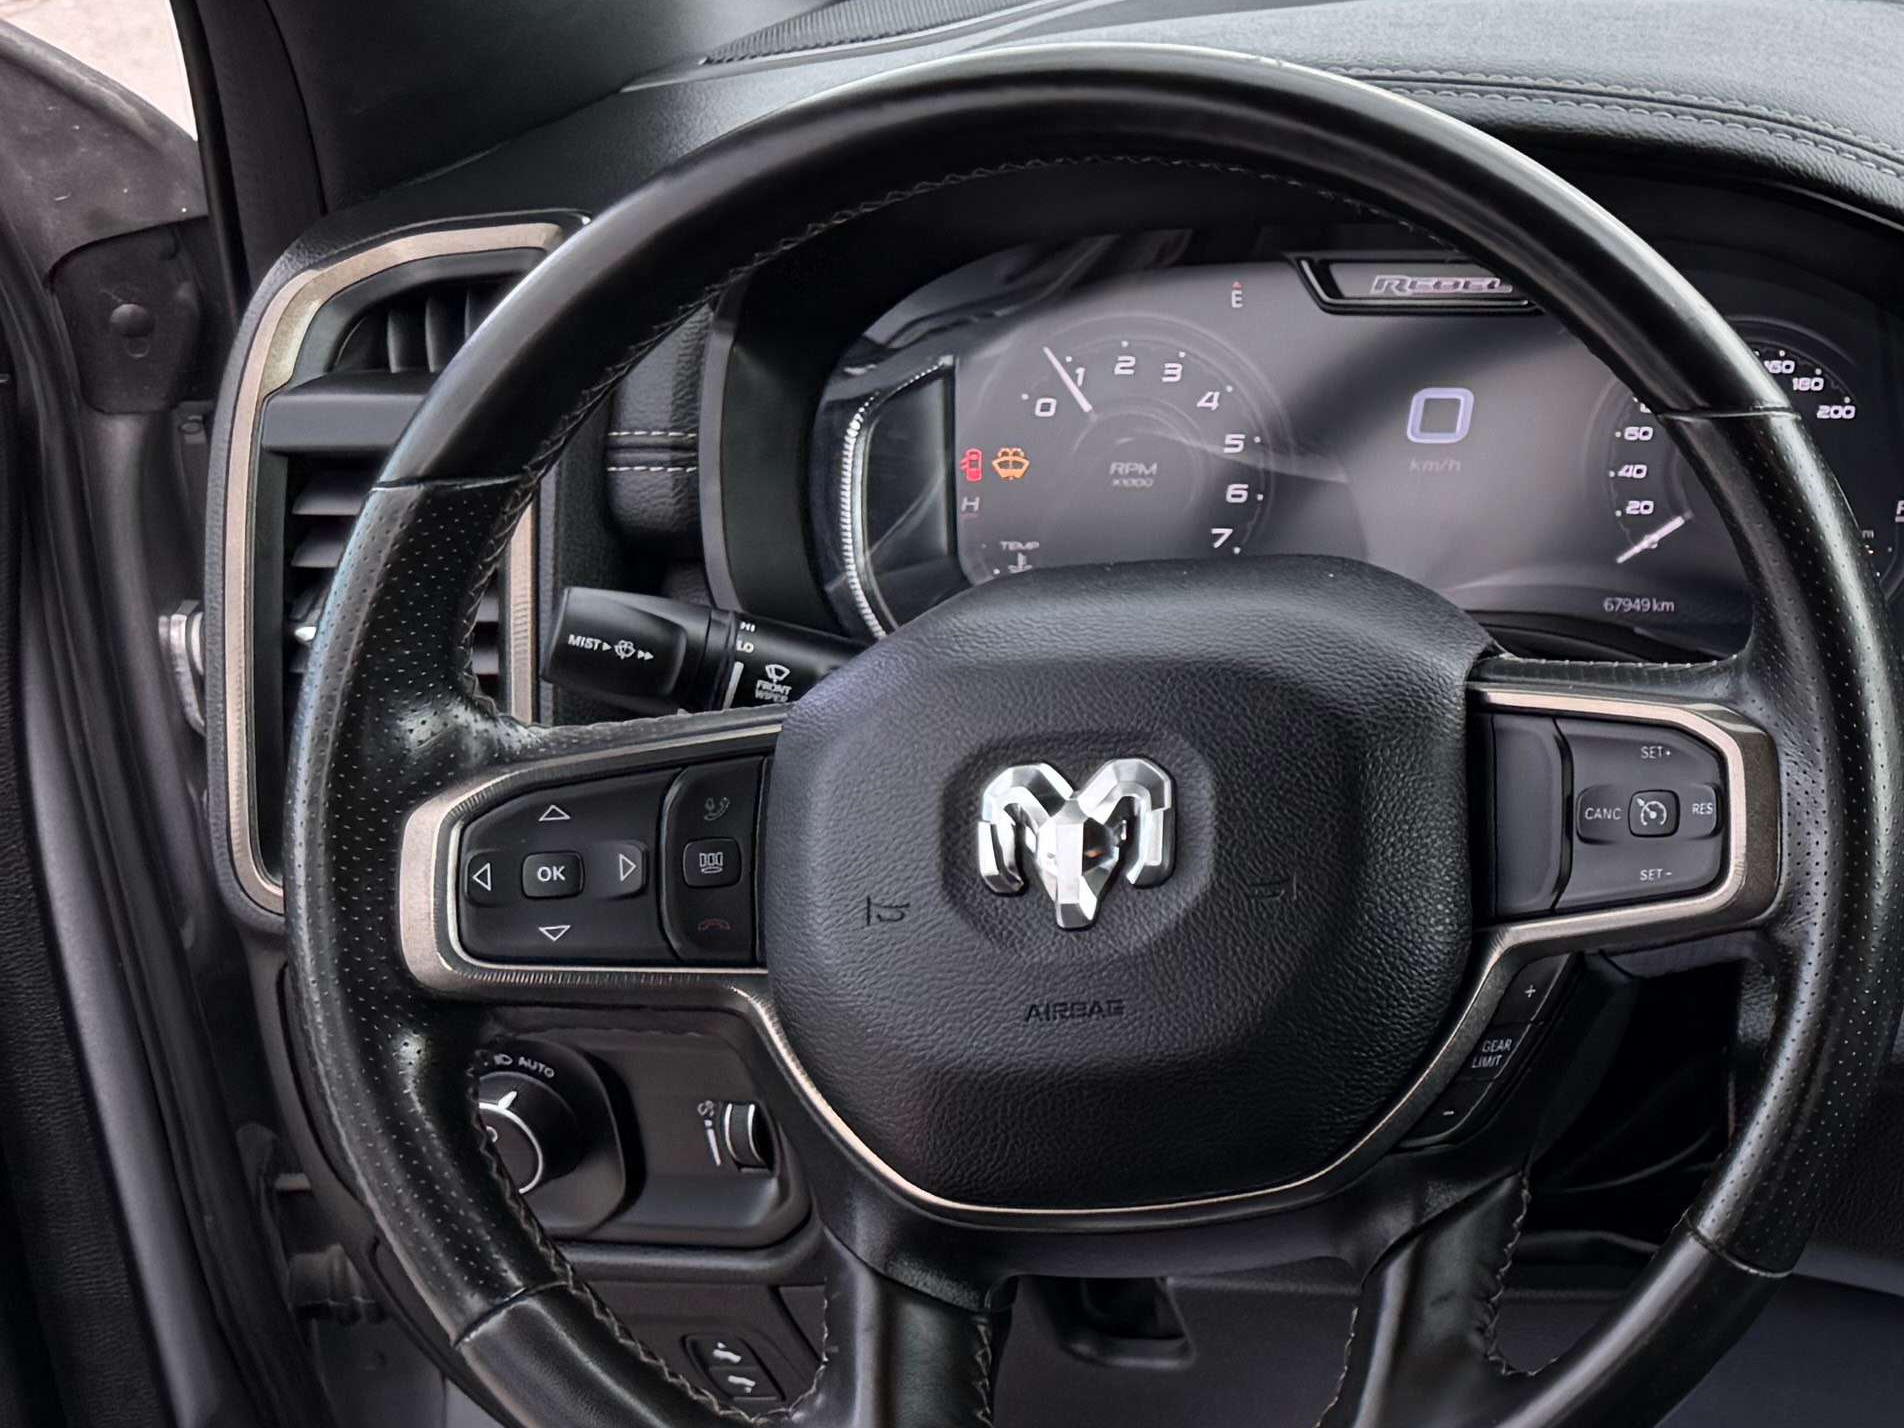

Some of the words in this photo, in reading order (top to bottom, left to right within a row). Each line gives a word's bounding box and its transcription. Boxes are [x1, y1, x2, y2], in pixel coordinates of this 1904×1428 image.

[1231, 290, 1243, 308] E
[1114, 356, 1137, 376] 2
[1161, 363, 1182, 383] 3
[1074, 367, 1086, 386] 1
[1034, 398, 1057, 418] 0
[1197, 391, 1221, 411] 4
[1406, 387, 1474, 444] 0
[1816, 405, 1856, 419] 200
[1623, 426, 1653, 441] 60
[1223, 434, 1244, 453] 5
[1109, 461, 1158, 476] RPM
[1617, 464, 1647, 479] 40
[1225, 484, 1248, 503] 6
[1625, 500, 1654, 515] 20
[1210, 529, 1232, 548] 7
[1603, 597, 1650, 613] 67949
[1653, 597, 1675, 613] km
[568, 634, 601, 650] MIST
[736, 640, 754, 653] LO
[757, 679, 792, 695] FRONT
[1585, 807, 1622, 821] CANC
[1692, 802, 1713, 815] RES
[537, 864, 565, 882] OK
[1024, 998, 1128, 1024] AIRBAG
[1482, 1037, 1513, 1052] GEAR
[517, 1055, 555, 1078] AUTO
[1472, 1053, 1503, 1068] LIMIT
